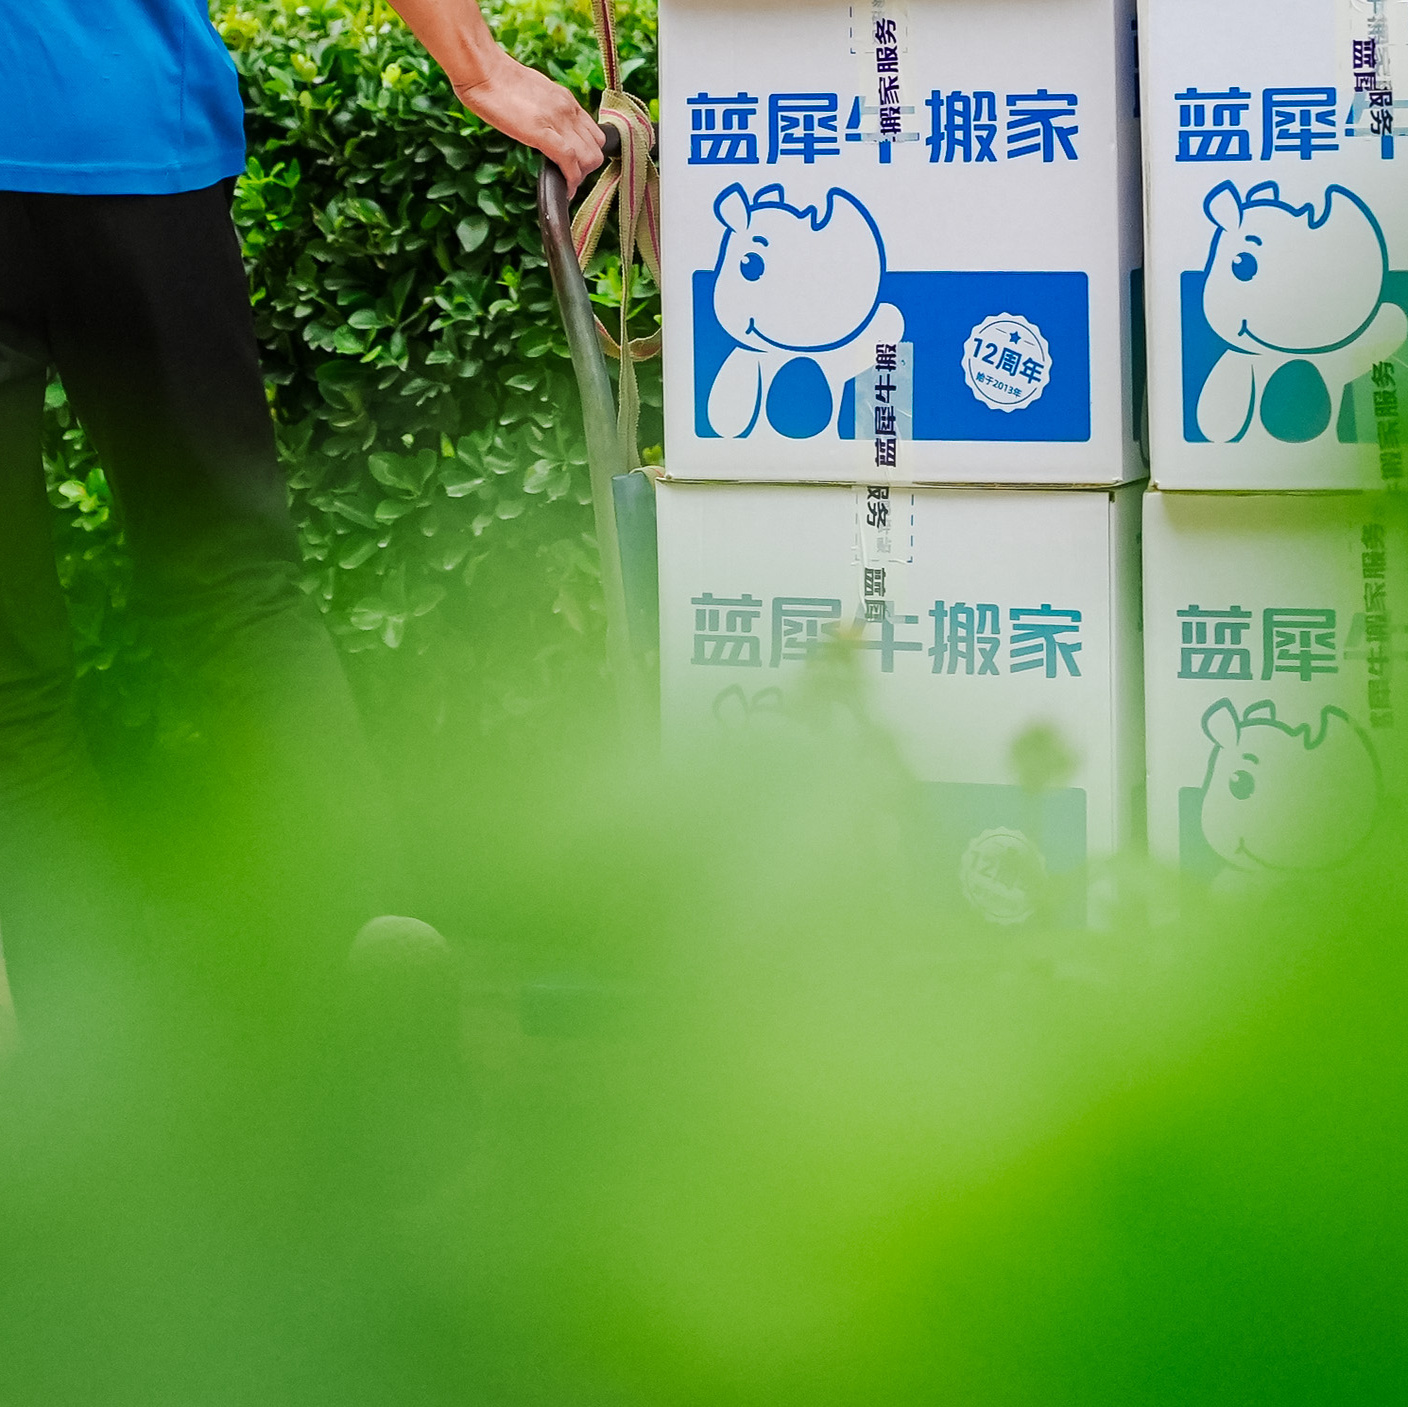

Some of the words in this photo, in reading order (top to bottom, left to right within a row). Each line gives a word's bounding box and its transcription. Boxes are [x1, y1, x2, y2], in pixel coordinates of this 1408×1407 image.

[686, 90, 1080, 165] 蓝犀牛搬家
[972, 337, 1044, 384] 12周年
[975, 371, 1022, 398] 始于2013年
[874, 343, 897, 468] 蓝犀牛搬
[690, 593, 1082, 679] 蓝犀牛搬家
